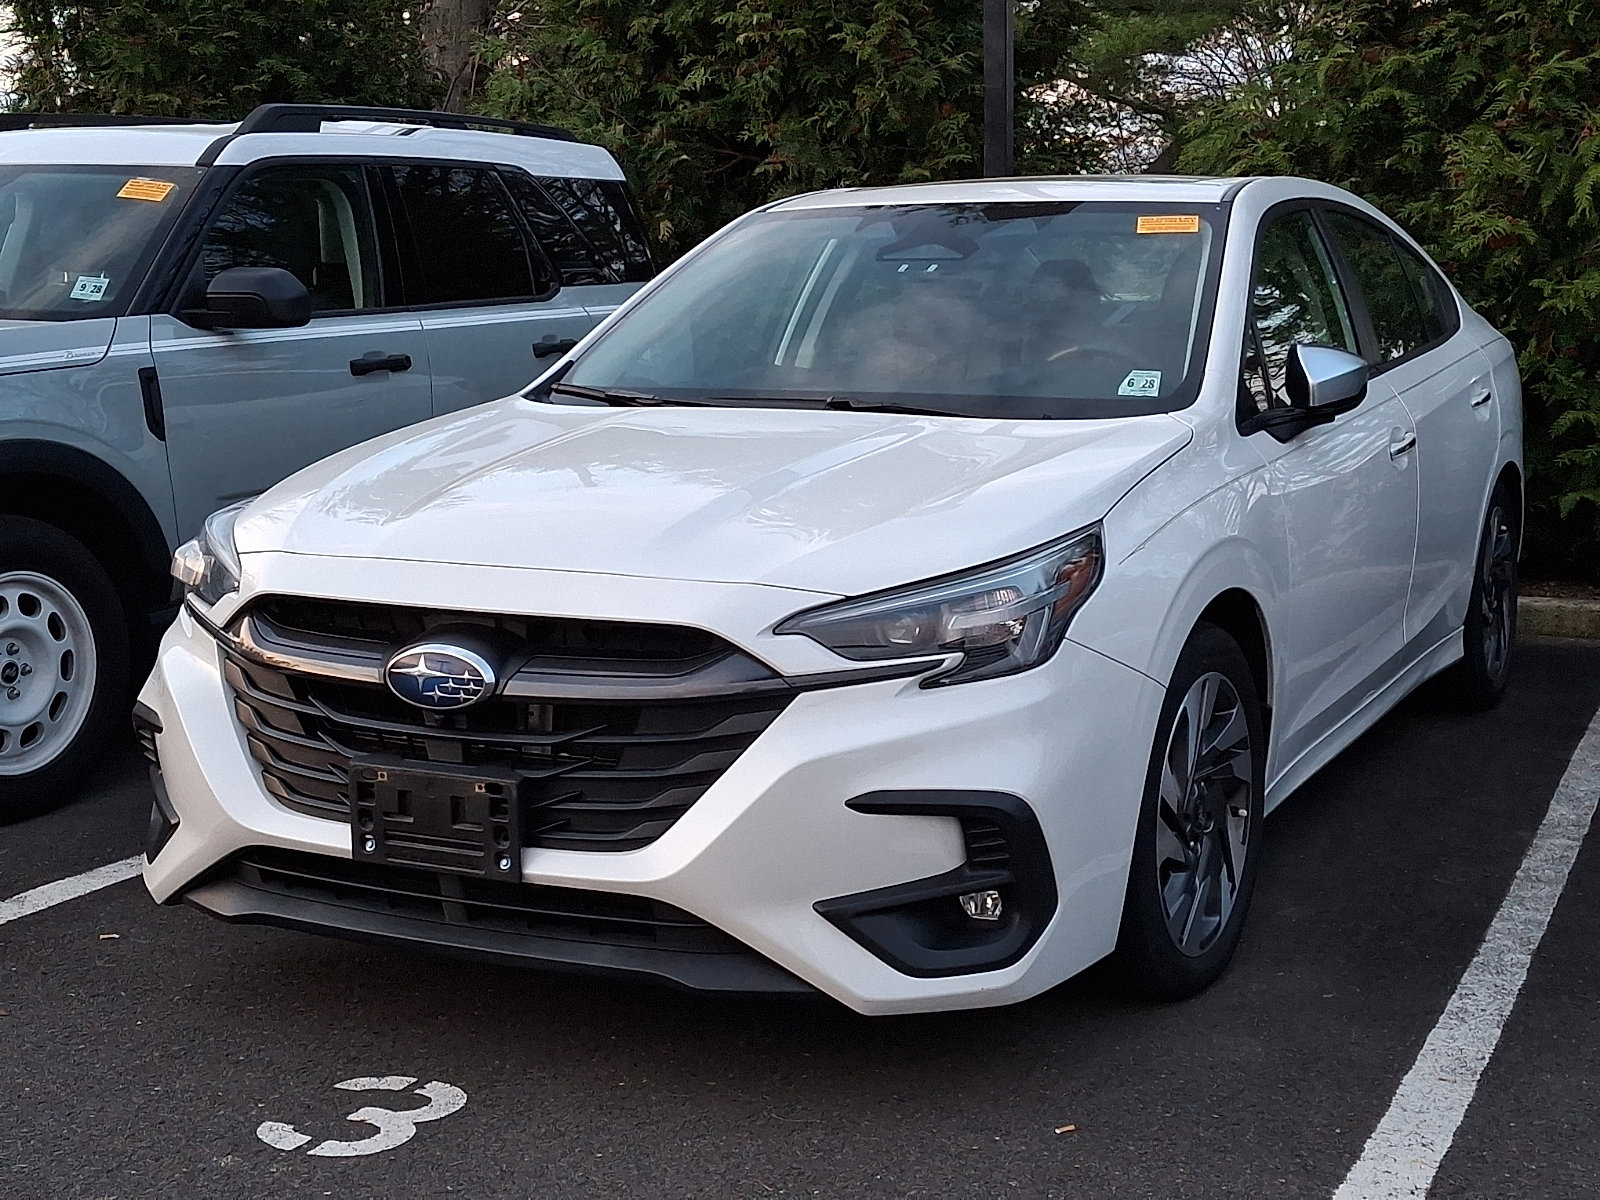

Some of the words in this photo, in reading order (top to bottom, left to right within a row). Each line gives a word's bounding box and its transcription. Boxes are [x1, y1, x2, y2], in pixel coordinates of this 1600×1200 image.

[79, 283, 87, 292] 9
[90, 284, 103, 294] 28
[1127, 377, 1136, 388] 6
[1140, 378, 1156, 389] 28
[256, 1075, 467, 1157] 3
